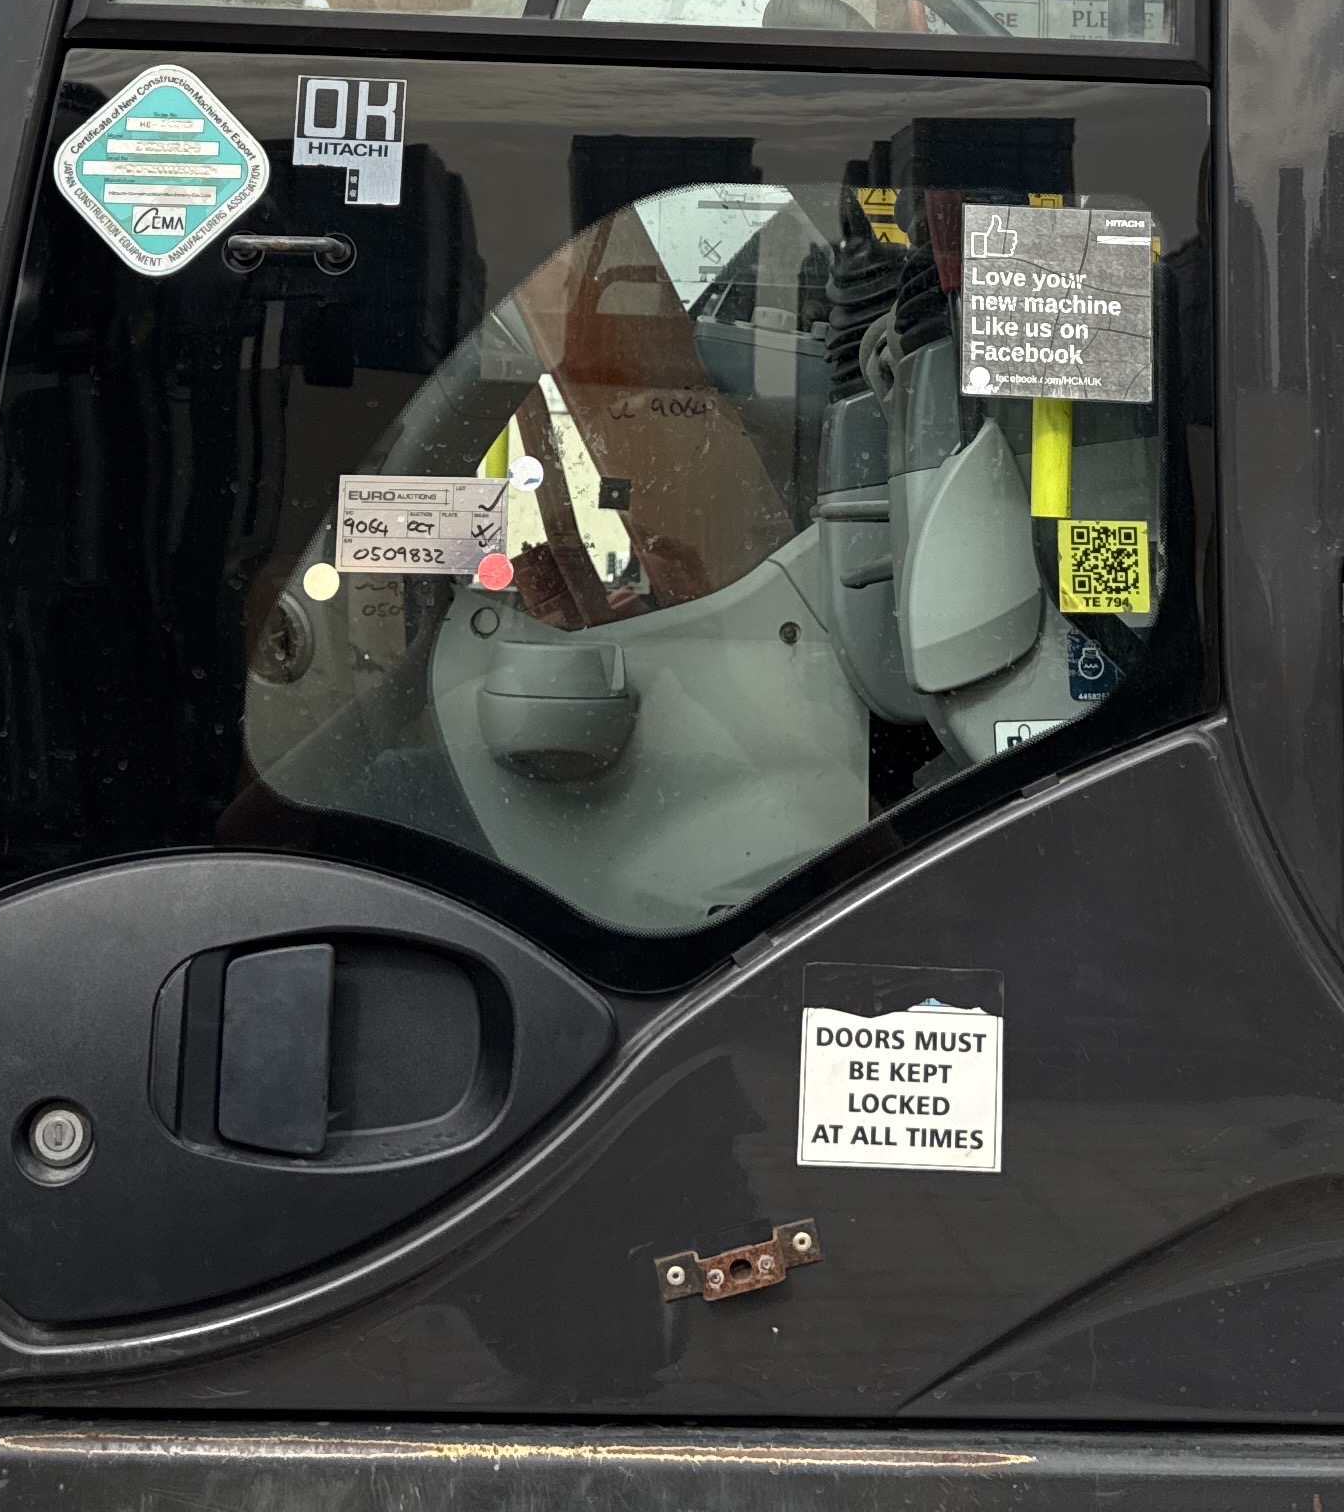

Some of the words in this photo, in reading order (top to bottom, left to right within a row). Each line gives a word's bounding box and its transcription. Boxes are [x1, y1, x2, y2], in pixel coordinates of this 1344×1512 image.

[70, 116, 113, 155] Certificate
[118, 94, 138, 112] New
[136, 75, 195, 96] Construction
[192, 91, 223, 125] Machine
[220, 121, 234, 135] for
[230, 132, 257, 161] Export
[303, 78, 398, 141] OK
[308, 141, 389, 158] HITACHI
[63, 161, 77, 188] JAPAN
[74, 188, 122, 238] CONSTRUCTION
[118, 235, 163, 267] EQUIPMENT
[167, 209, 228, 263] MANUFACTURERS
[226, 164, 261, 213] ASSOCIATION
[133, 207, 185, 234] CEMA
[1105, 219, 1145, 228] HITACHI
[971, 267, 1027, 287] Love
[1031, 272, 1087, 292] your
[971, 294, 1018, 312] new
[1024, 295, 1122, 316] machine
[971, 316, 1019, 337] Like
[1025, 321, 1052, 338] us
[1060, 323, 1089, 339] on
[970, 341, 1084, 365] Facebook
[348, 490, 396, 501] EURO
[343, 517, 389, 537] 9064
[353, 546, 446, 564] 0509832
[1083, 596, 1102, 608] TE
[1105, 596, 1130, 608] 794
[816, 1026, 905, 1050] DOORS
[915, 1030, 987, 1053] MUST
[849, 1060, 880, 1081] BE
[889, 1062, 952, 1084] KEPT
[848, 1092, 951, 1116] LOCKED
[811, 1124, 843, 1144] AT
[850, 1125, 898, 1146] ALL
[906, 1127, 984, 1150] TIMES
